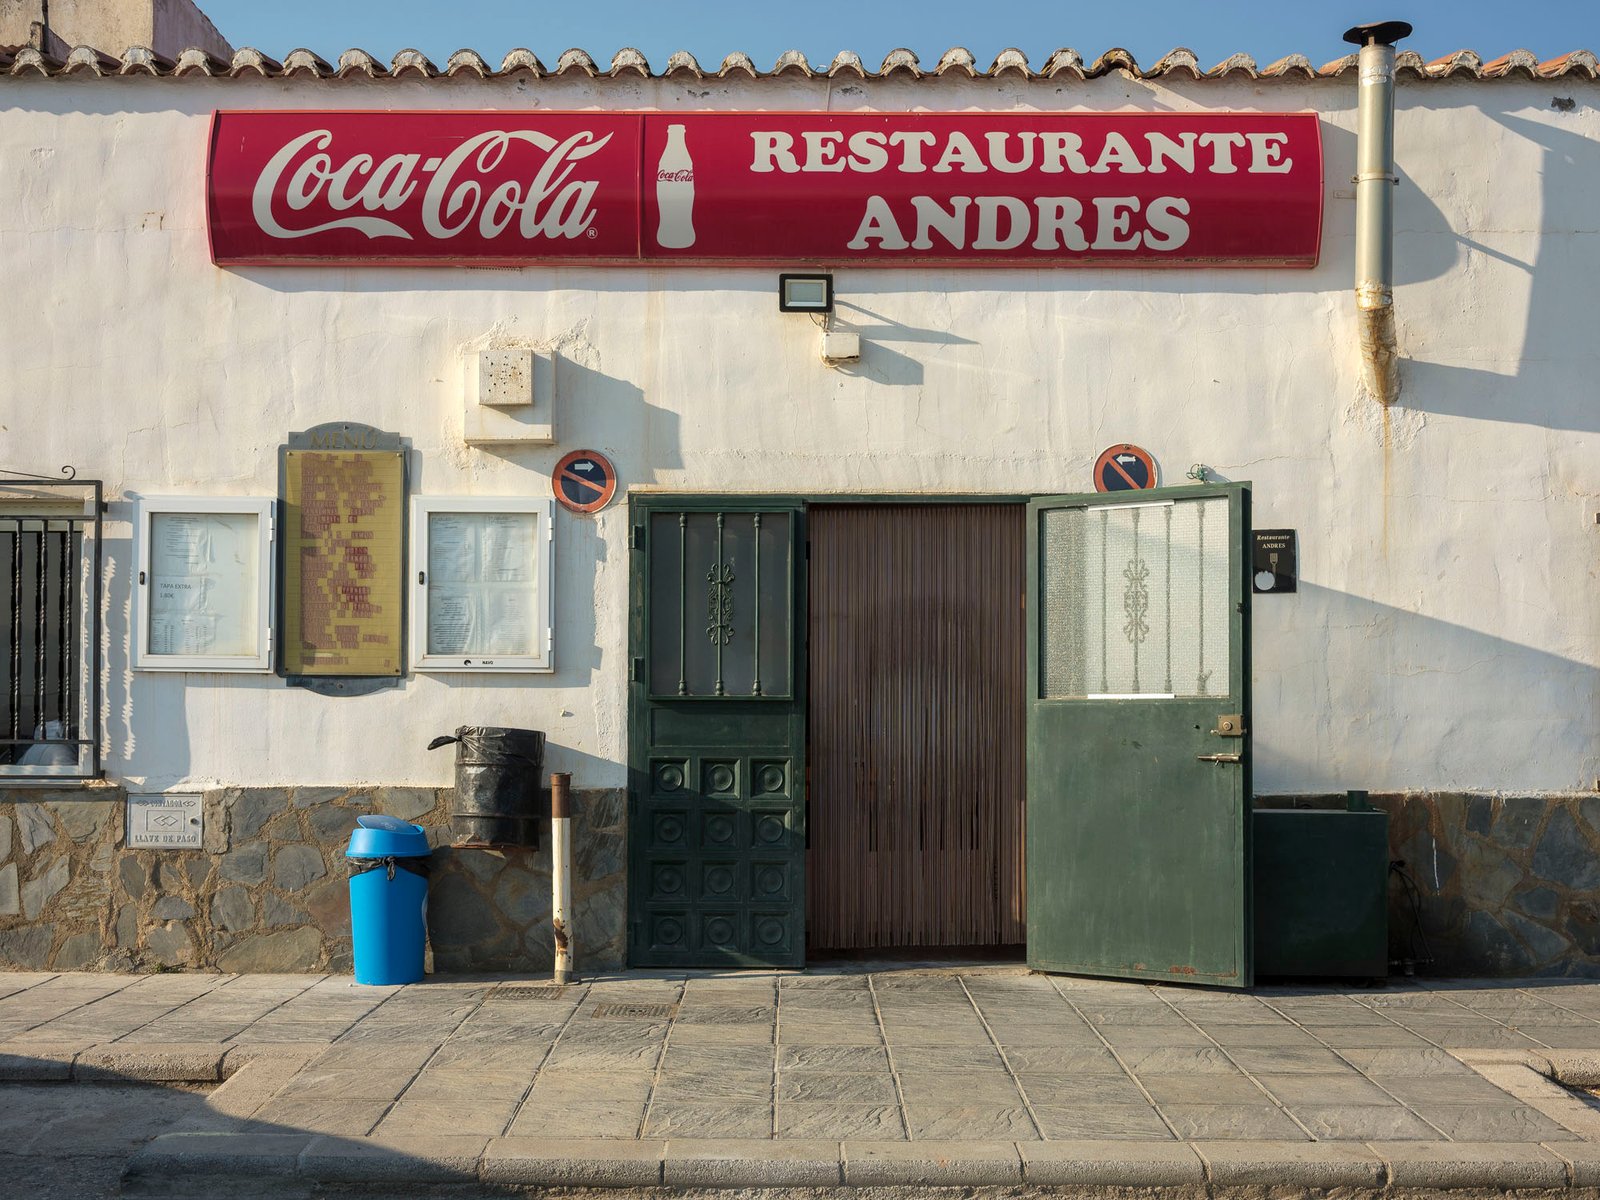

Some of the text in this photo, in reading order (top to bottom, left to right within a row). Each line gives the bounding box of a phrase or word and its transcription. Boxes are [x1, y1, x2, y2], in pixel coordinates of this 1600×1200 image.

[750, 131, 1293, 174] RESTAURANTE
[252, 129, 614, 240] Coca-Cola
[846, 196, 1191, 251] ANDRES
[135, 834, 197, 843] LLAVE DE PASO
